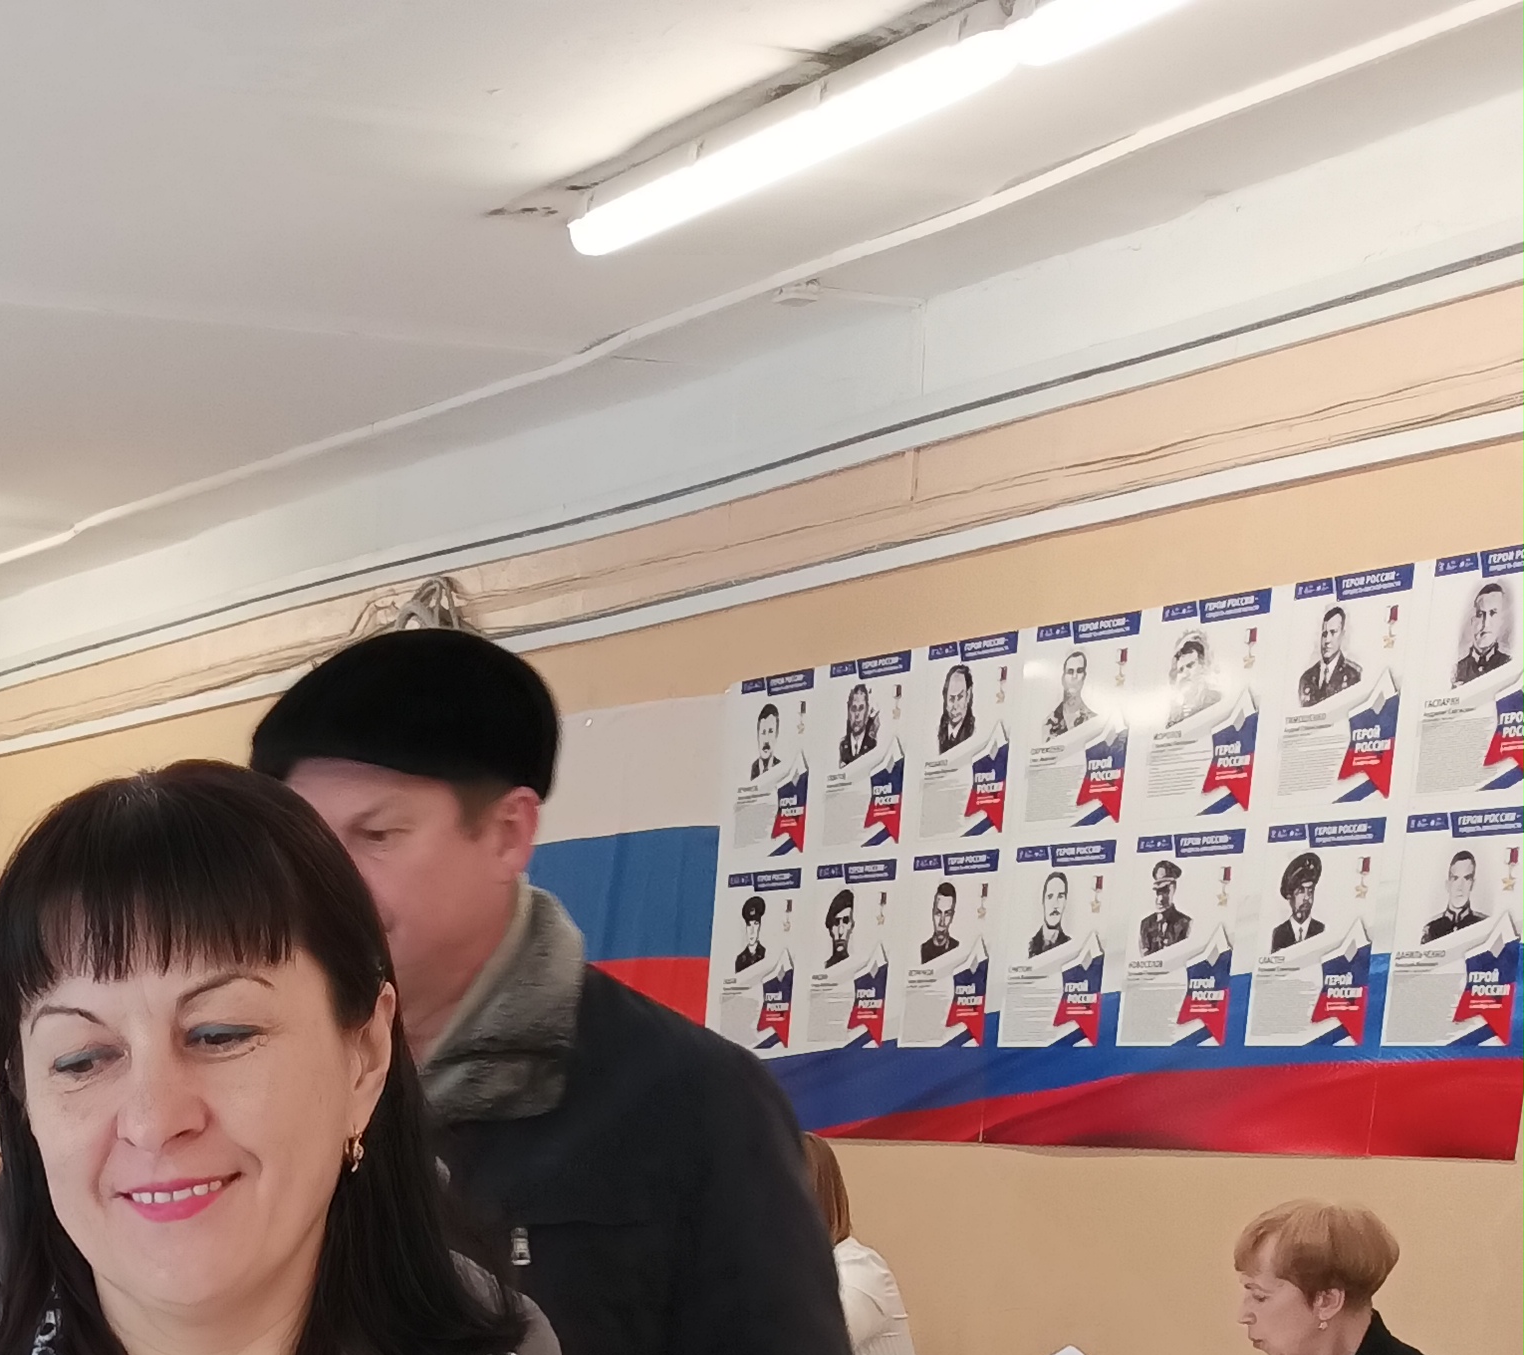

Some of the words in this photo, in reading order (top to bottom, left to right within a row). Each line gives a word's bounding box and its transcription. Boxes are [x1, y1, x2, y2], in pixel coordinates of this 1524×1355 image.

[1499, 711, 1524, 725] ГЕРО
[1468, 968, 1499, 983] ГЕРОЙ
[1471, 984, 1511, 997] РОССИИ
